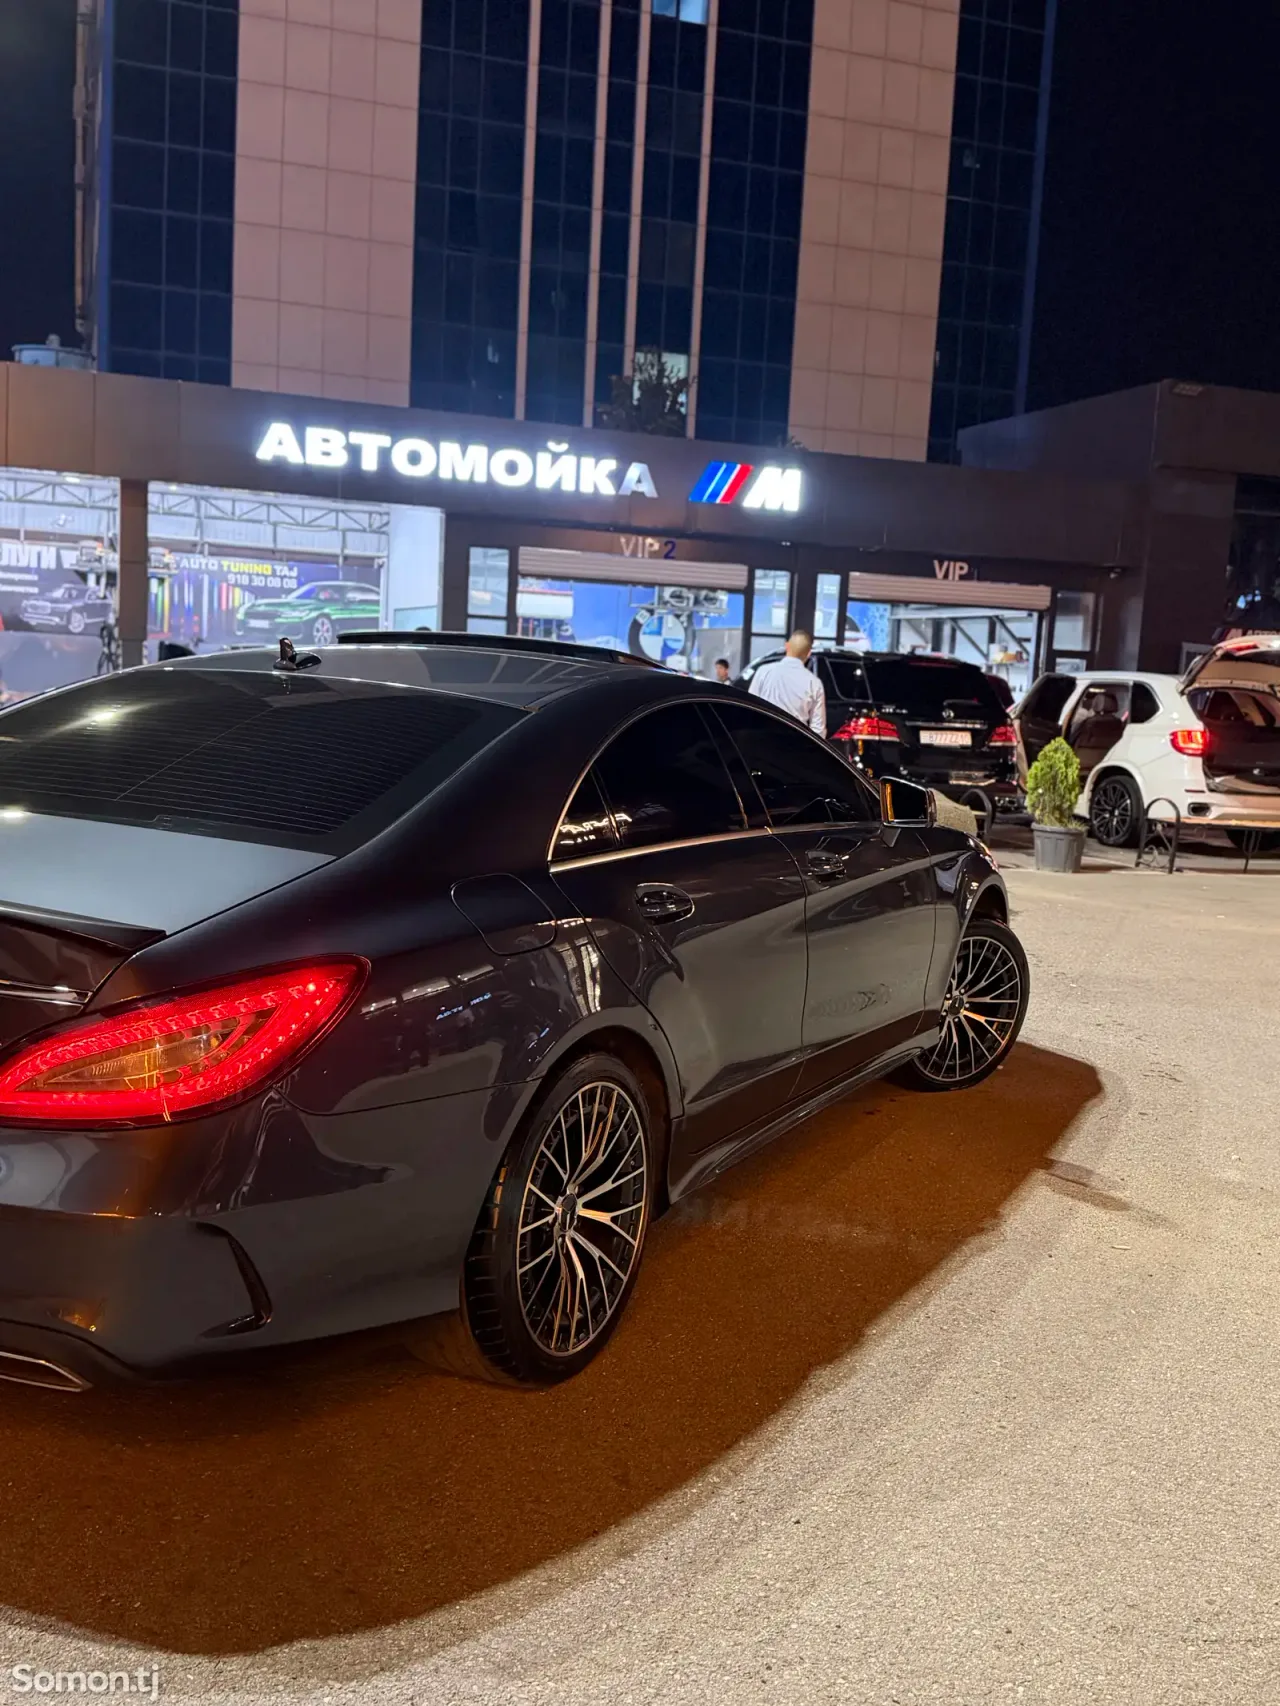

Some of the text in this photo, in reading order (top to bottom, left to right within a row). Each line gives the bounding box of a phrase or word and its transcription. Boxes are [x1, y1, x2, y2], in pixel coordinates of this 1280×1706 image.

[255, 422, 659, 499] АВТОМОЙКА
[620, 536, 677, 560] VIP 2
[180, 558, 219, 571] AUTO
[273, 565, 299, 578] TAJ
[933, 560, 969, 581] VIP
